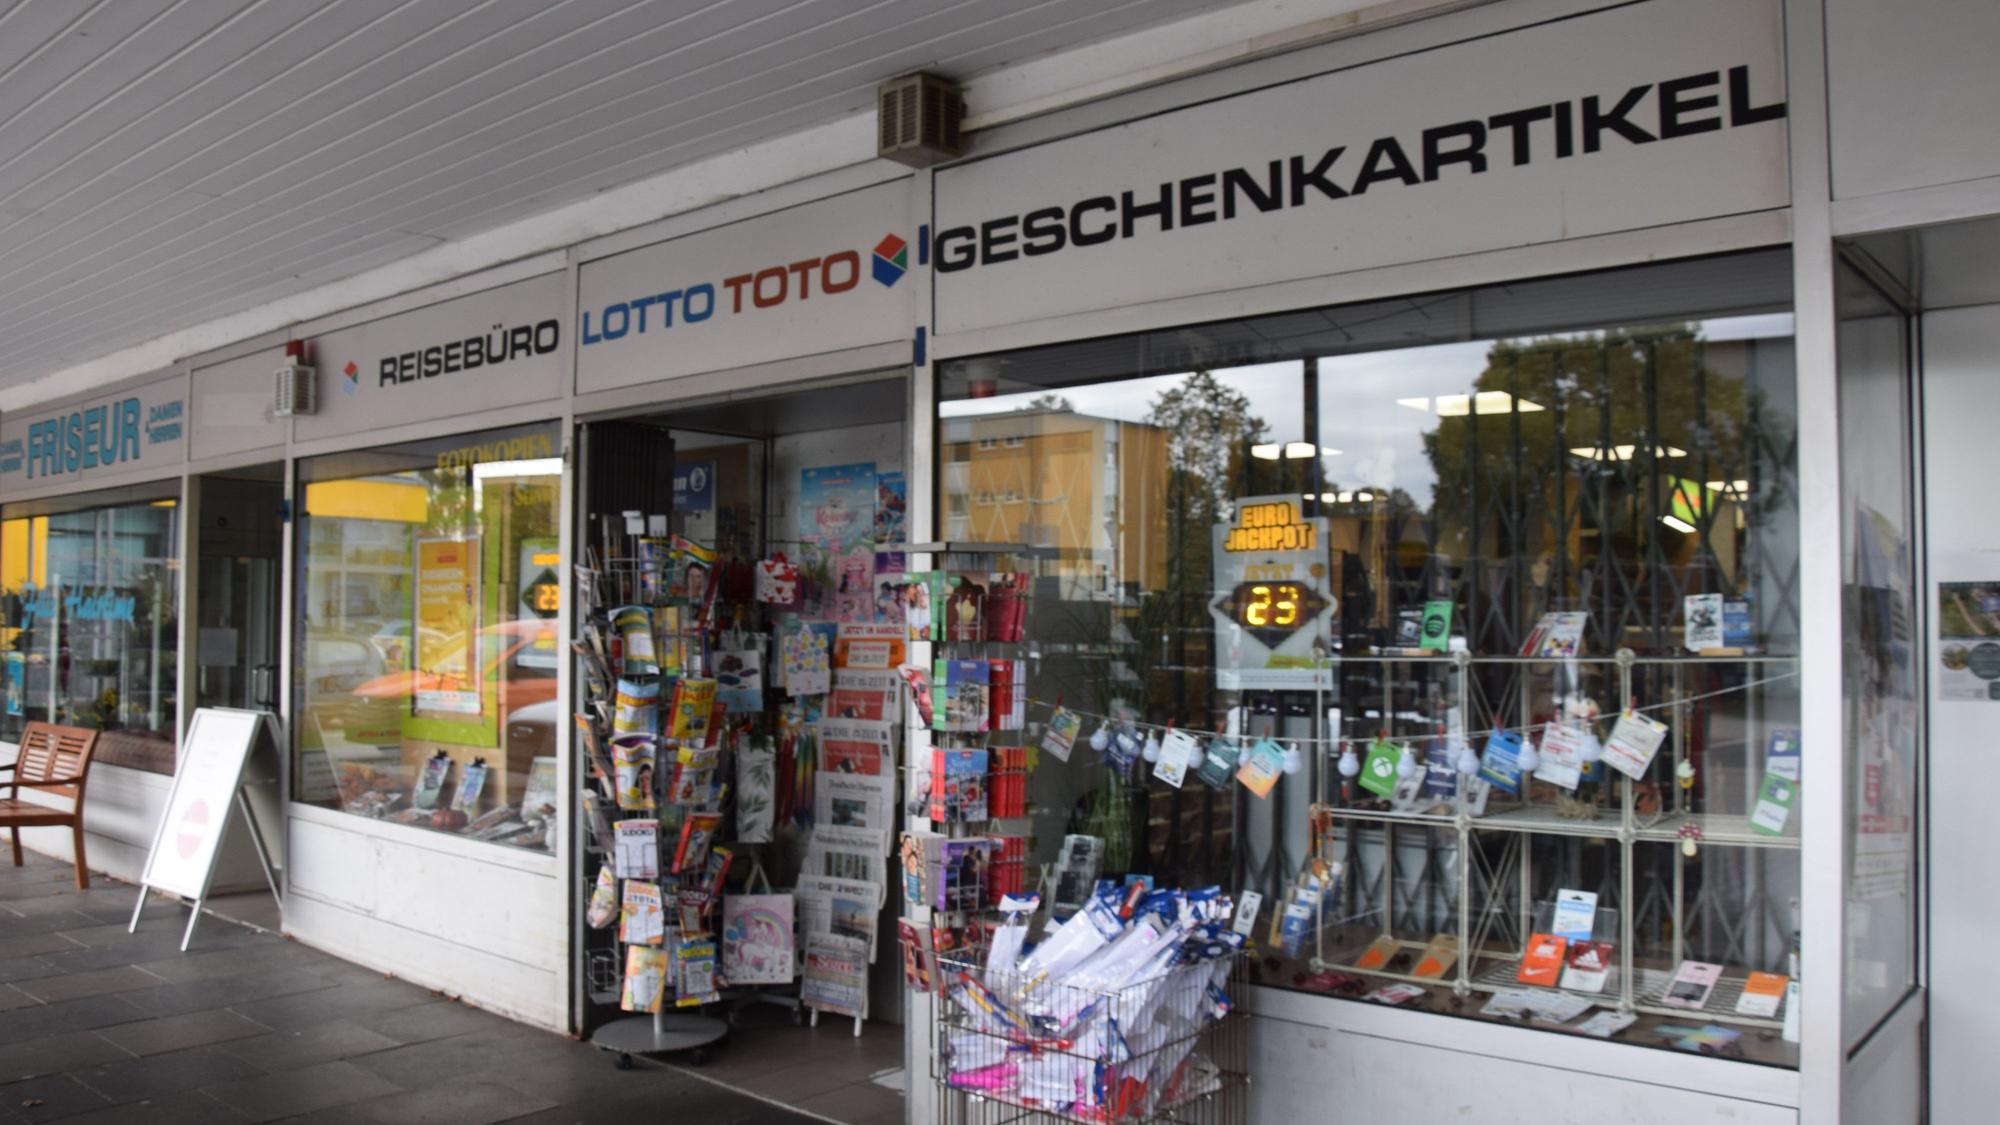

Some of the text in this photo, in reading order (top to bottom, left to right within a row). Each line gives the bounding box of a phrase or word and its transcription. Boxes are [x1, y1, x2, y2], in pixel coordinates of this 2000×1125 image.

[935, 64, 1787, 273] GESCHENKARTIKEL
[583, 250, 860, 345] LOTTO TOTO
[379, 319, 559, 387] REISEBÜRO
[27, 397, 141, 479] FRISEUR
[437, 434, 552, 469] FOTOKOPIEN
[1225, 523, 1312, 552] JACKPOT
[1240, 502, 1292, 528] EURO
